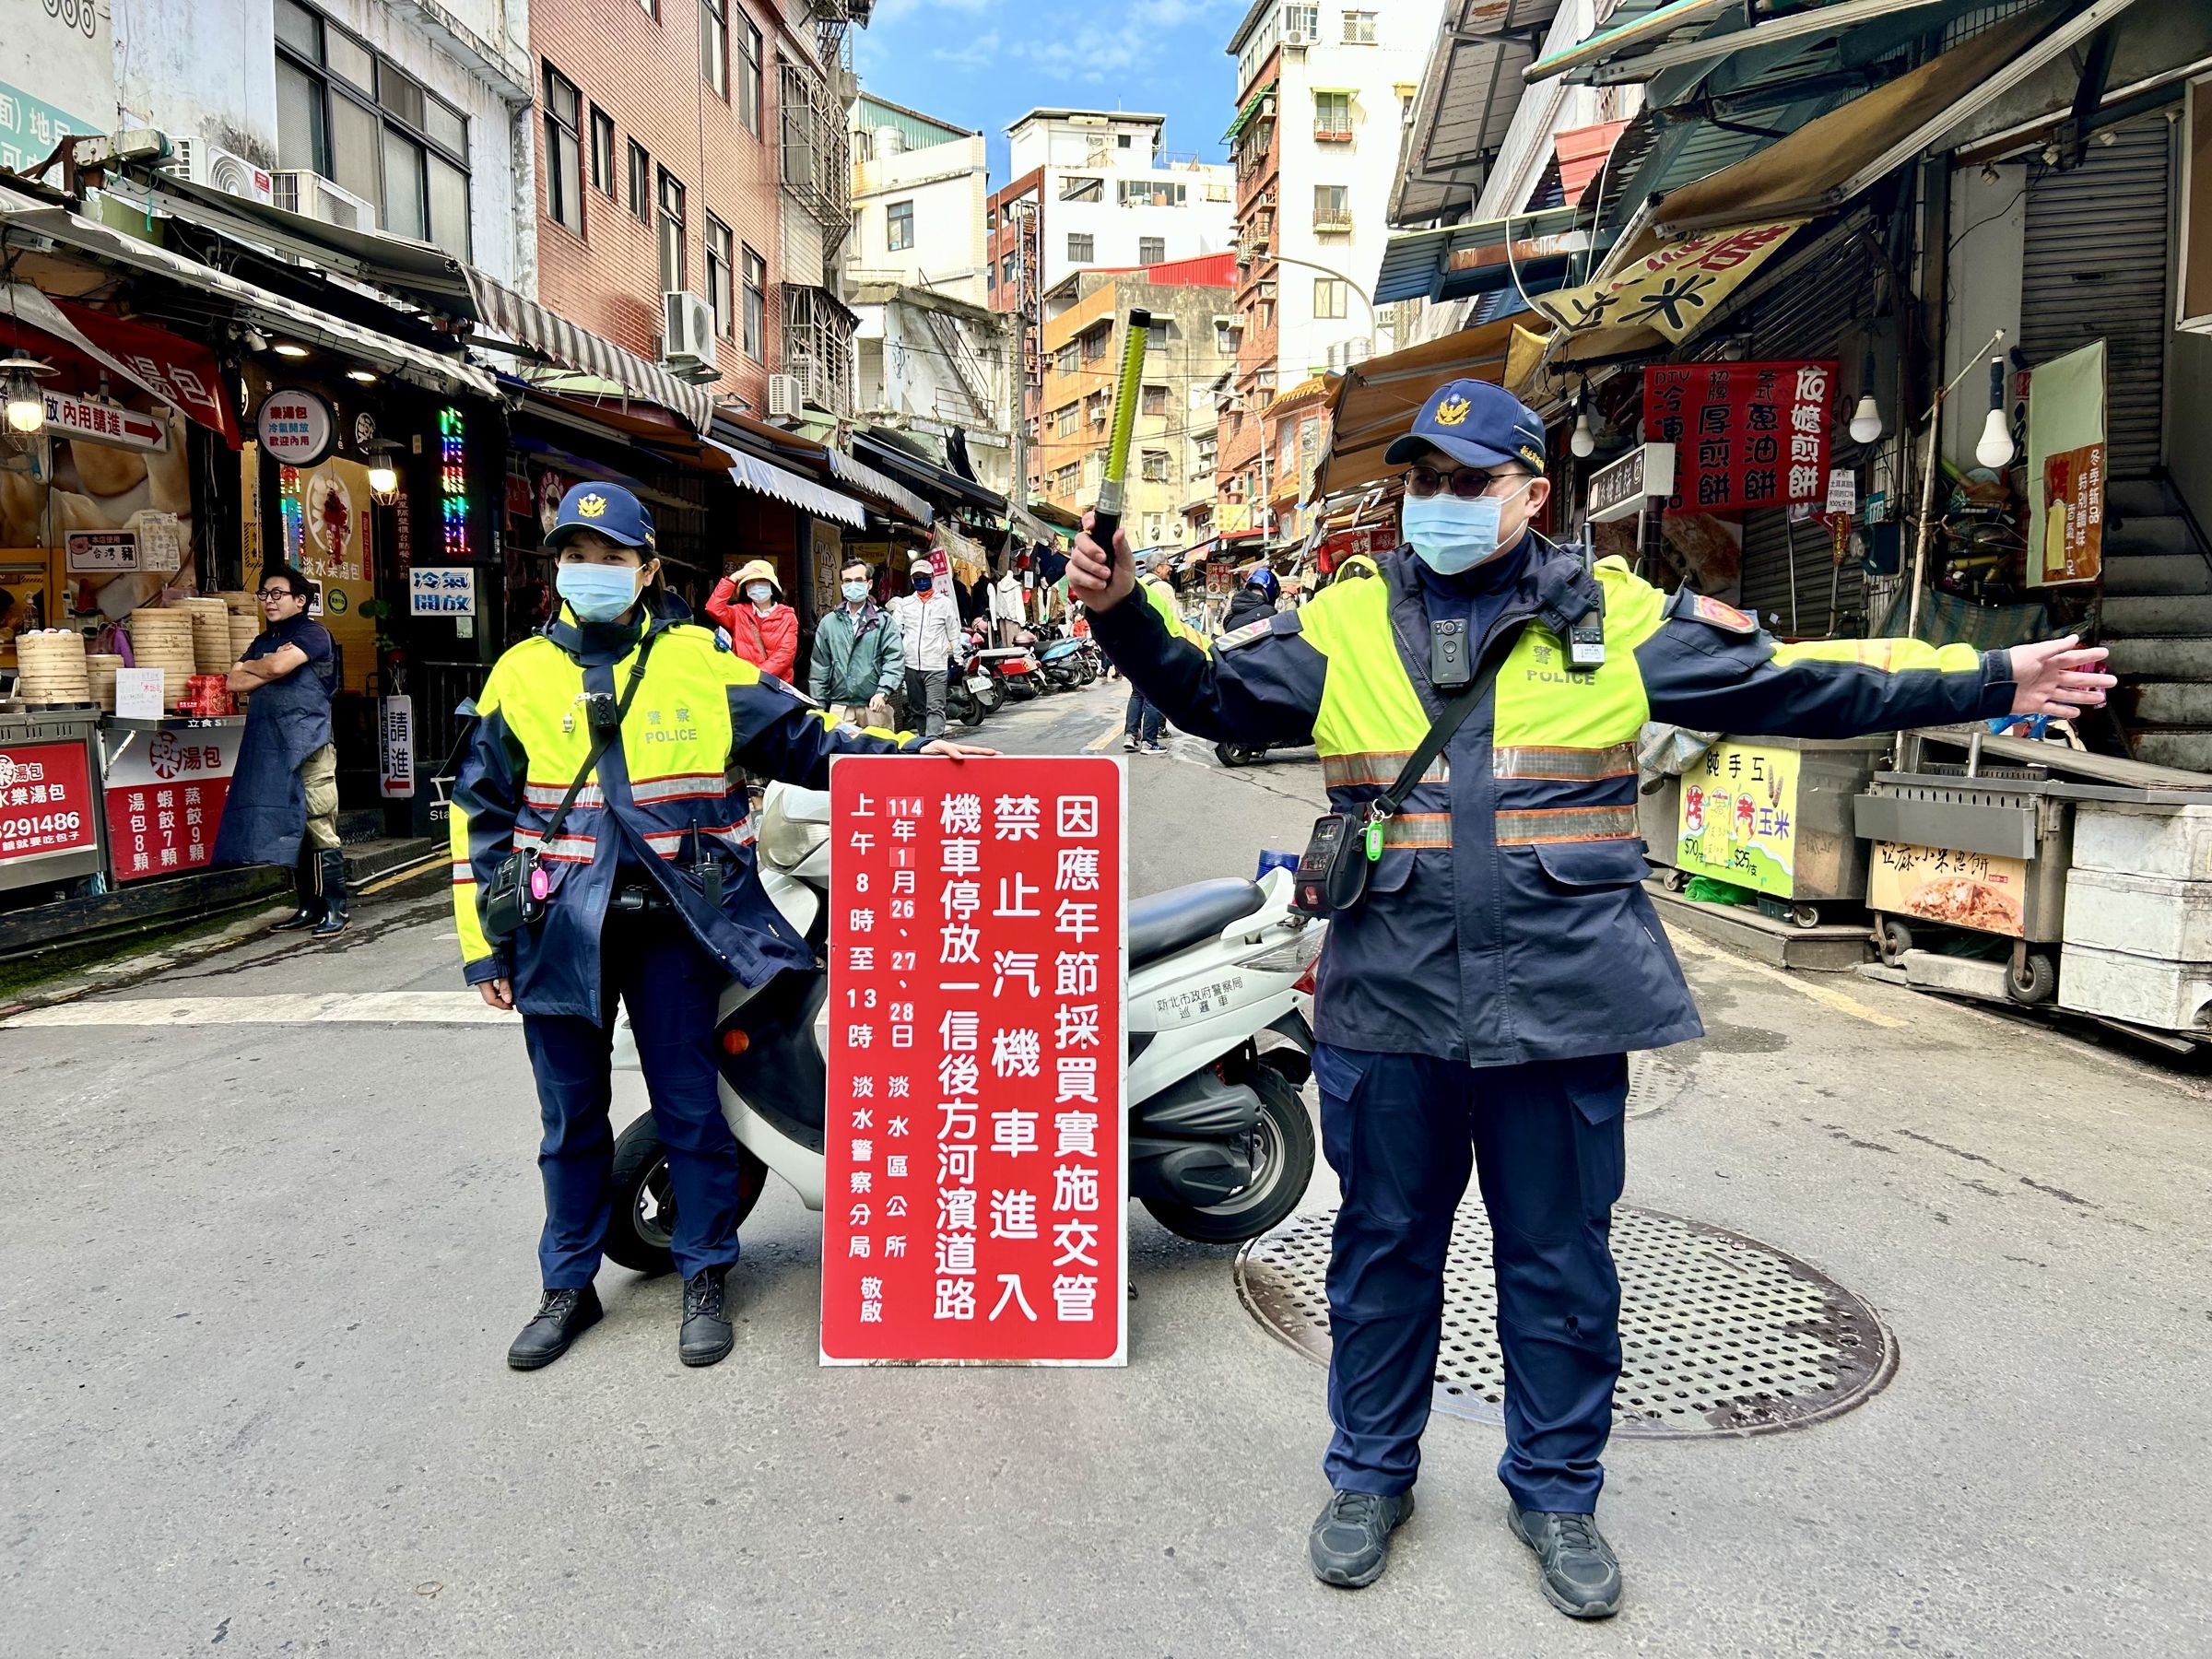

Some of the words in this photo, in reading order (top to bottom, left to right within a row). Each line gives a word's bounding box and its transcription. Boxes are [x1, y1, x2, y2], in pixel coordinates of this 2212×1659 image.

[63, 400, 121, 436] 內用請進
[268, 422, 310, 433] 冷氣開放
[269, 436, 310, 446] 歡迎內用
[1870, 500, 1884, 524] 116
[414, 571, 470, 590] 冷氣
[414, 594, 472, 613] 開放
[1526, 669, 1596, 686] POLICE
[647, 707, 691, 725] 警察
[390, 711, 410, 779] 請進
[645, 728, 698, 744] POLICE
[1706, 750, 1765, 782] 純手工
[0, 811, 80, 840] 291486
[127, 792, 149, 872] 湯包8顆
[157, 790, 178, 866] 蝦餃7顆
[184, 787, 205, 862] 蒸餃9顆
[1758, 807, 1790, 841] 玉米
[846, 793, 877, 1049] 上午8時至13時
[1157, 976, 1243, 1011] 新北市政府警察局
[1179, 995, 1229, 1019] 巡邏車
[933, 793, 982, 1321] 機車停放一信後方河濱道路
[988, 794, 1041, 1322] 禁止汽機車進入
[1052, 795, 1100, 1322] 因應年節採買實施交管
[849, 1076, 875, 1258] 淡水警察分局
[884, 1076, 910, 1258] 淡水區公所
